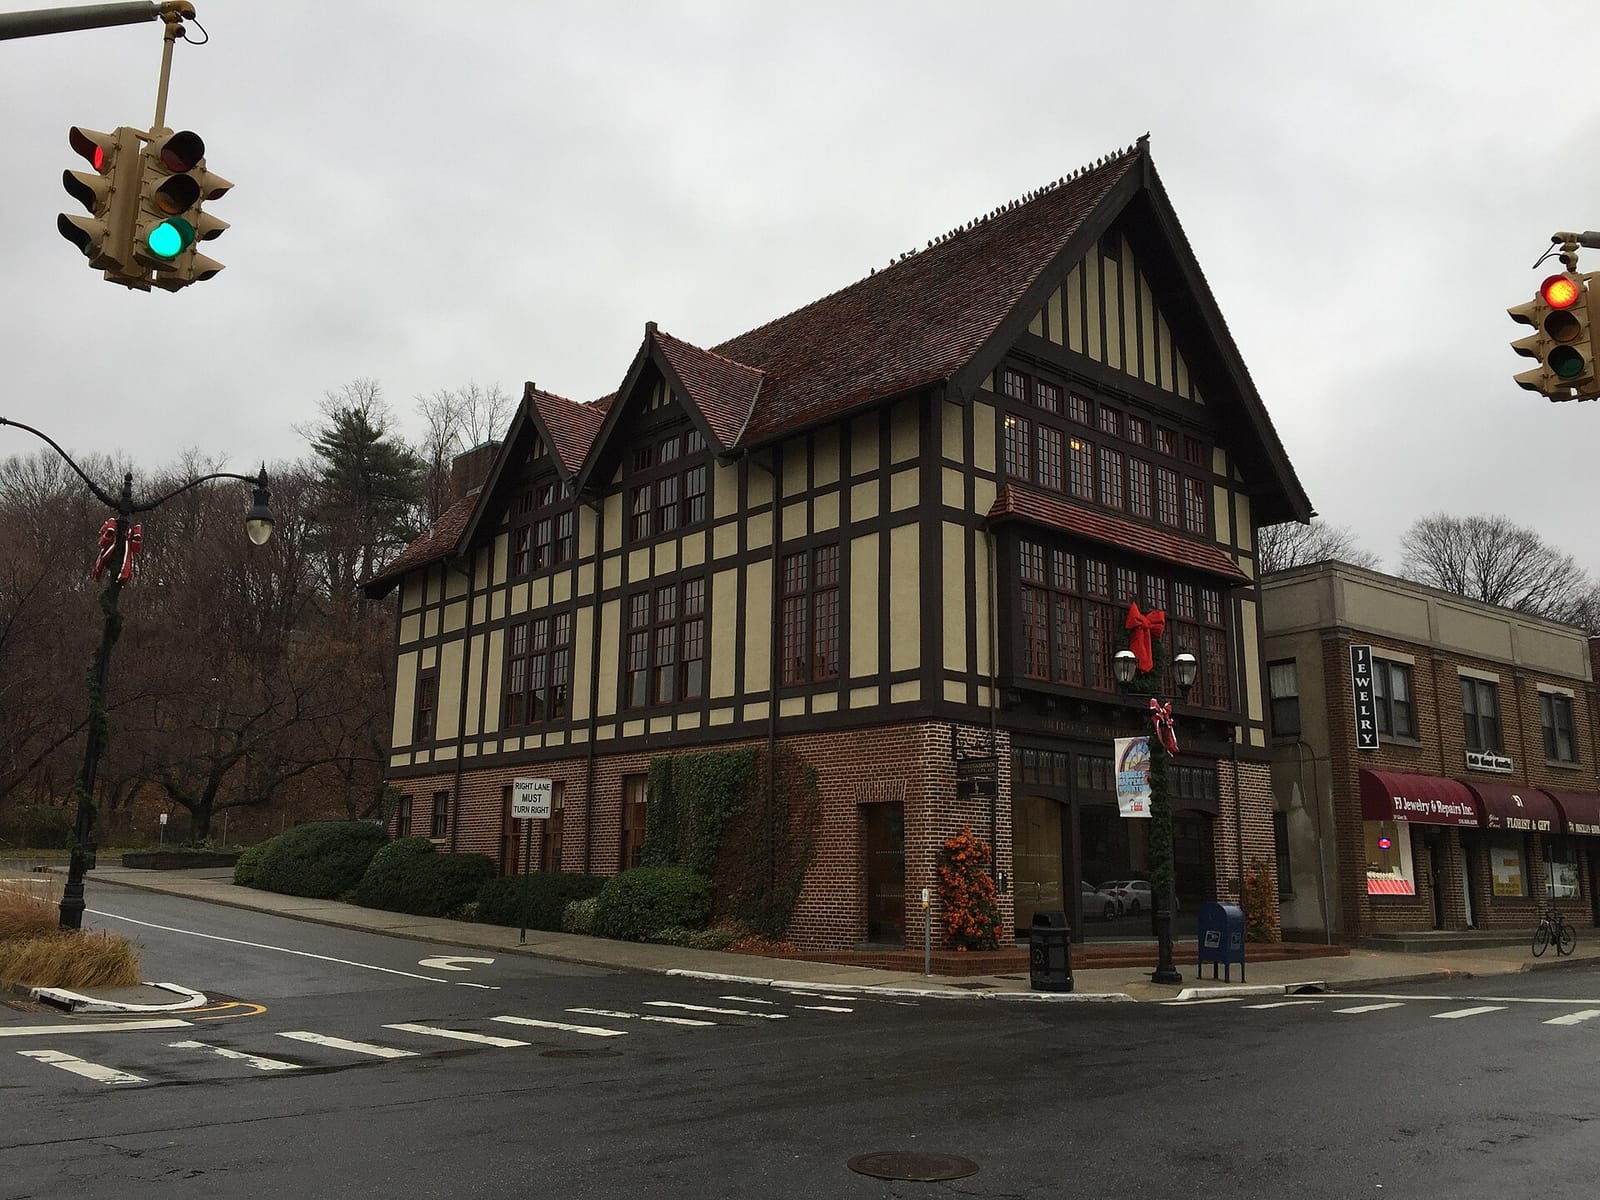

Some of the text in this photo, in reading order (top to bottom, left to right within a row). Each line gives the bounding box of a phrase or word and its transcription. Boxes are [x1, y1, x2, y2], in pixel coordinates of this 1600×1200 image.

[1355, 649, 1373, 744] JEWELRY
[515, 782, 550, 791] RIGHT LANE
[522, 793, 542, 803] MUST
[514, 805, 549, 814] TURN RIGHT
[1393, 796, 1402, 810] FJ
[1403, 797, 1430, 815] Jewelry
[1436, 800, 1461, 817] Repairs
[1506, 817, 1530, 830] FLORIST
[1537, 820, 1551, 832] GIFT
